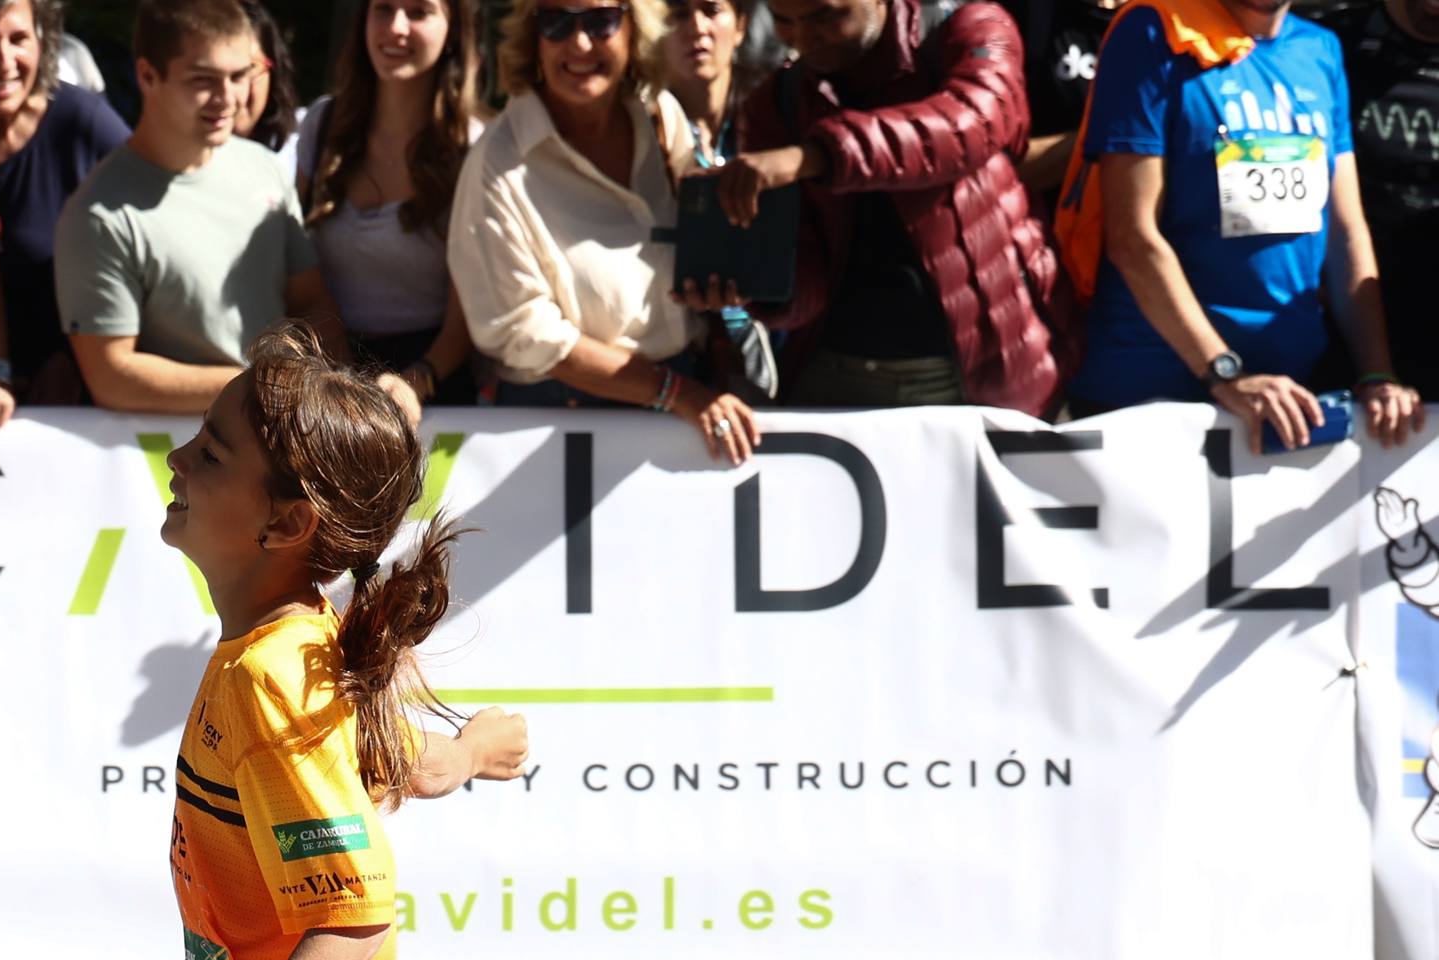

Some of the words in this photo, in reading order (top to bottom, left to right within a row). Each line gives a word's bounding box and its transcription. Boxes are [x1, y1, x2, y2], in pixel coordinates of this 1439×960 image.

[1245, 166, 1307, 202] 338
[582, 750, 1073, 793] CONSTRUCCIÓN
[394, 876, 835, 932] avidel.es
